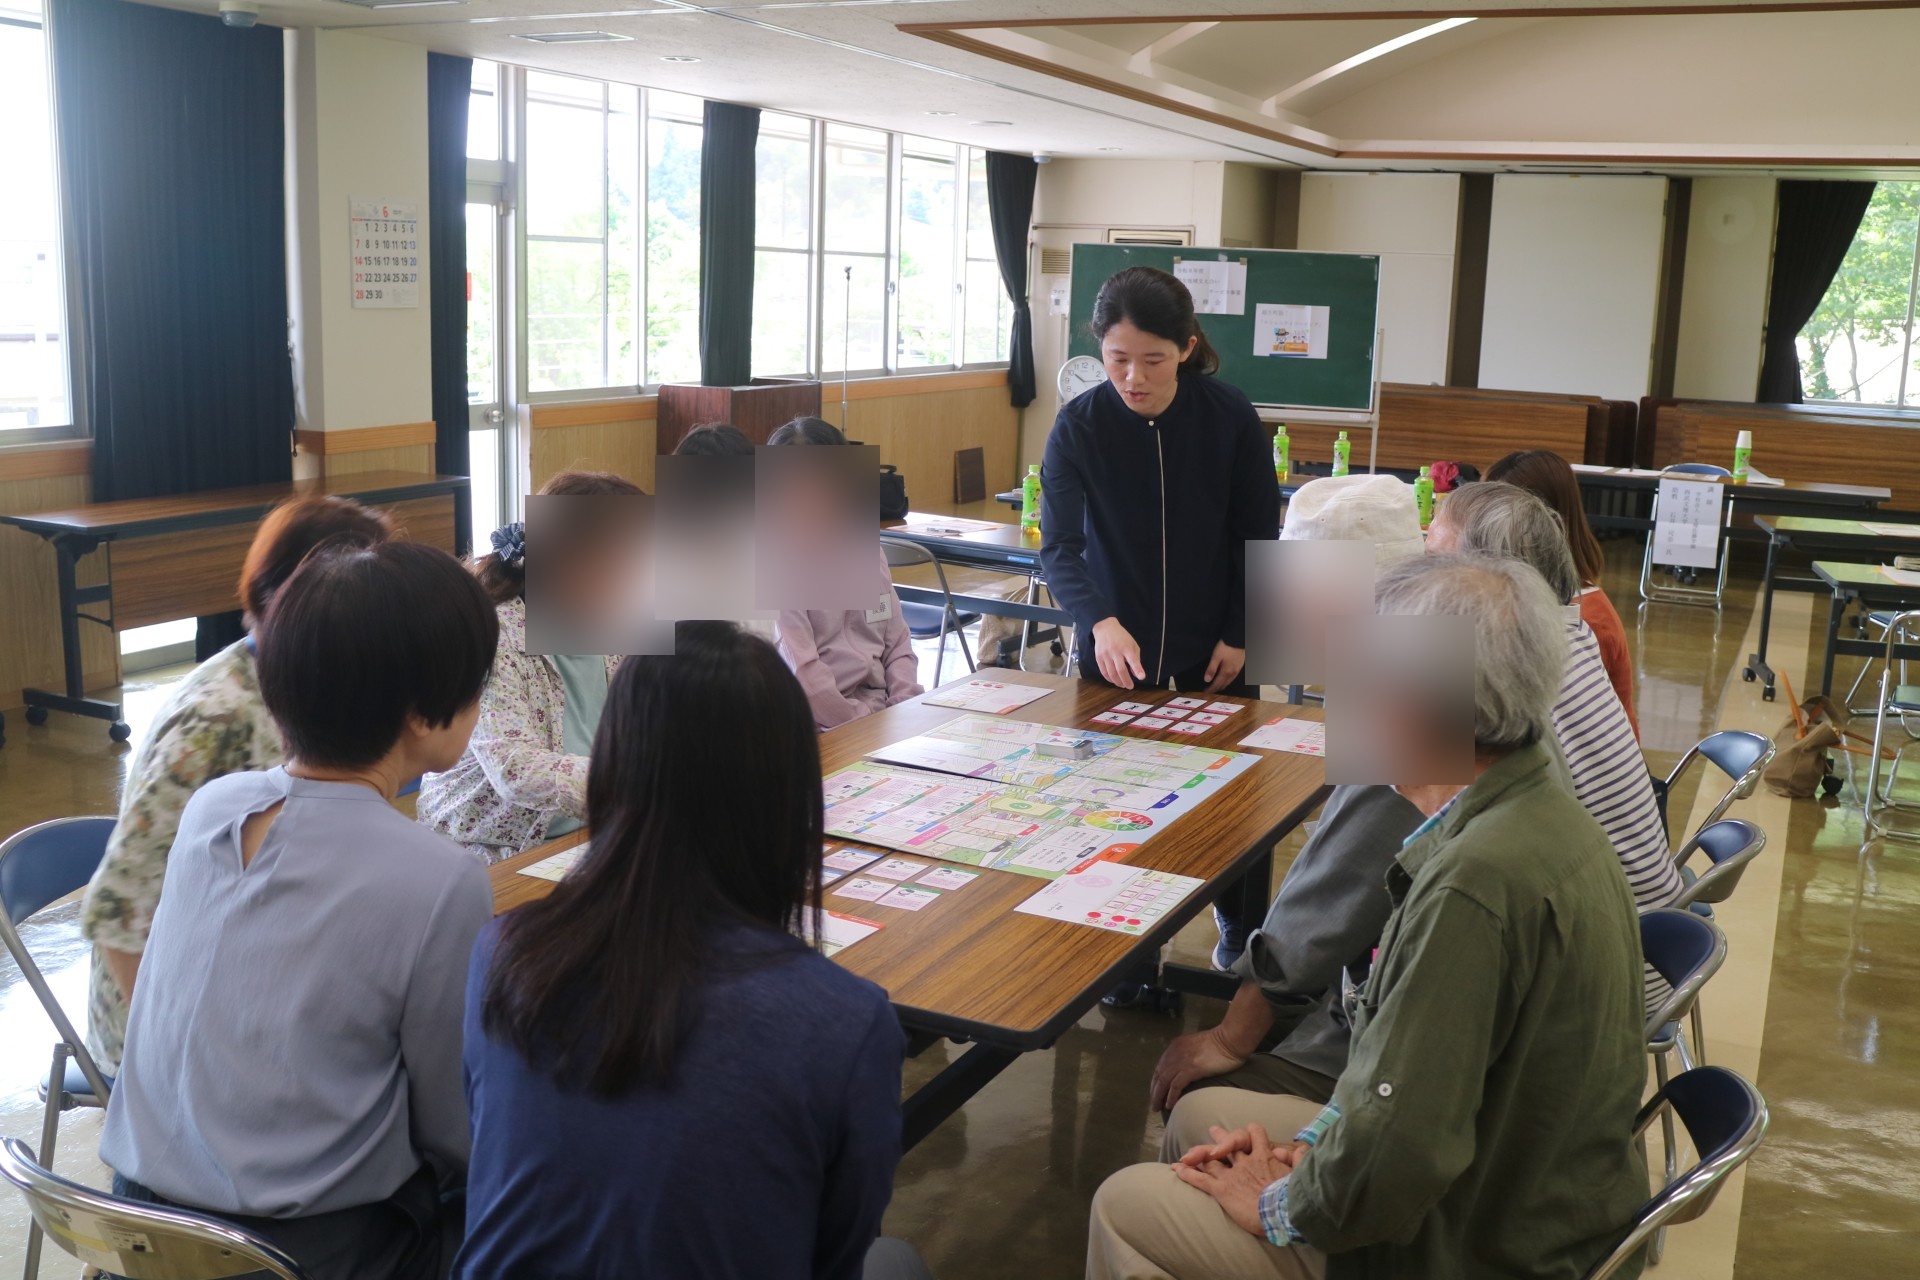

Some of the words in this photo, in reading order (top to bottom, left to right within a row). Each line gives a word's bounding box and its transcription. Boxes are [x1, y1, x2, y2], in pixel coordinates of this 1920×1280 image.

[382, 206, 389, 218] 6
[365, 223, 369, 232] 1
[374, 223, 379, 232] 2
[383, 223, 388, 233] 3
[392, 224, 397, 233] 4
[401, 224, 406, 233] 5
[410, 225, 414, 233] 6
[355, 239, 360, 249] 7
[365, 240, 370, 249] 8
[375, 240, 379, 249] 9
[383, 240, 390, 249] 10
[392, 240, 399, 249] 11
[401, 240, 408, 250] 12
[409, 241, 416, 250] 13
[354, 256, 362, 266] 14
[364, 256, 372, 266] 15
[374, 256, 381, 266] 16
[383, 257, 390, 266] 17
[392, 257, 399, 266] 18
[401, 257, 408, 266] 19
[410, 257, 417, 266] 20
[355, 273, 362, 283] 21
[364, 273, 372, 283] 22
[374, 273, 381, 283] 23
[383, 273, 391, 283] 24
[392, 273, 400, 283] 25
[401, 273, 409, 283] 26
[410, 274, 417, 283] 27
[355, 290, 364, 300] 28
[365, 290, 373, 299] 29
[375, 290, 383, 299] 30
